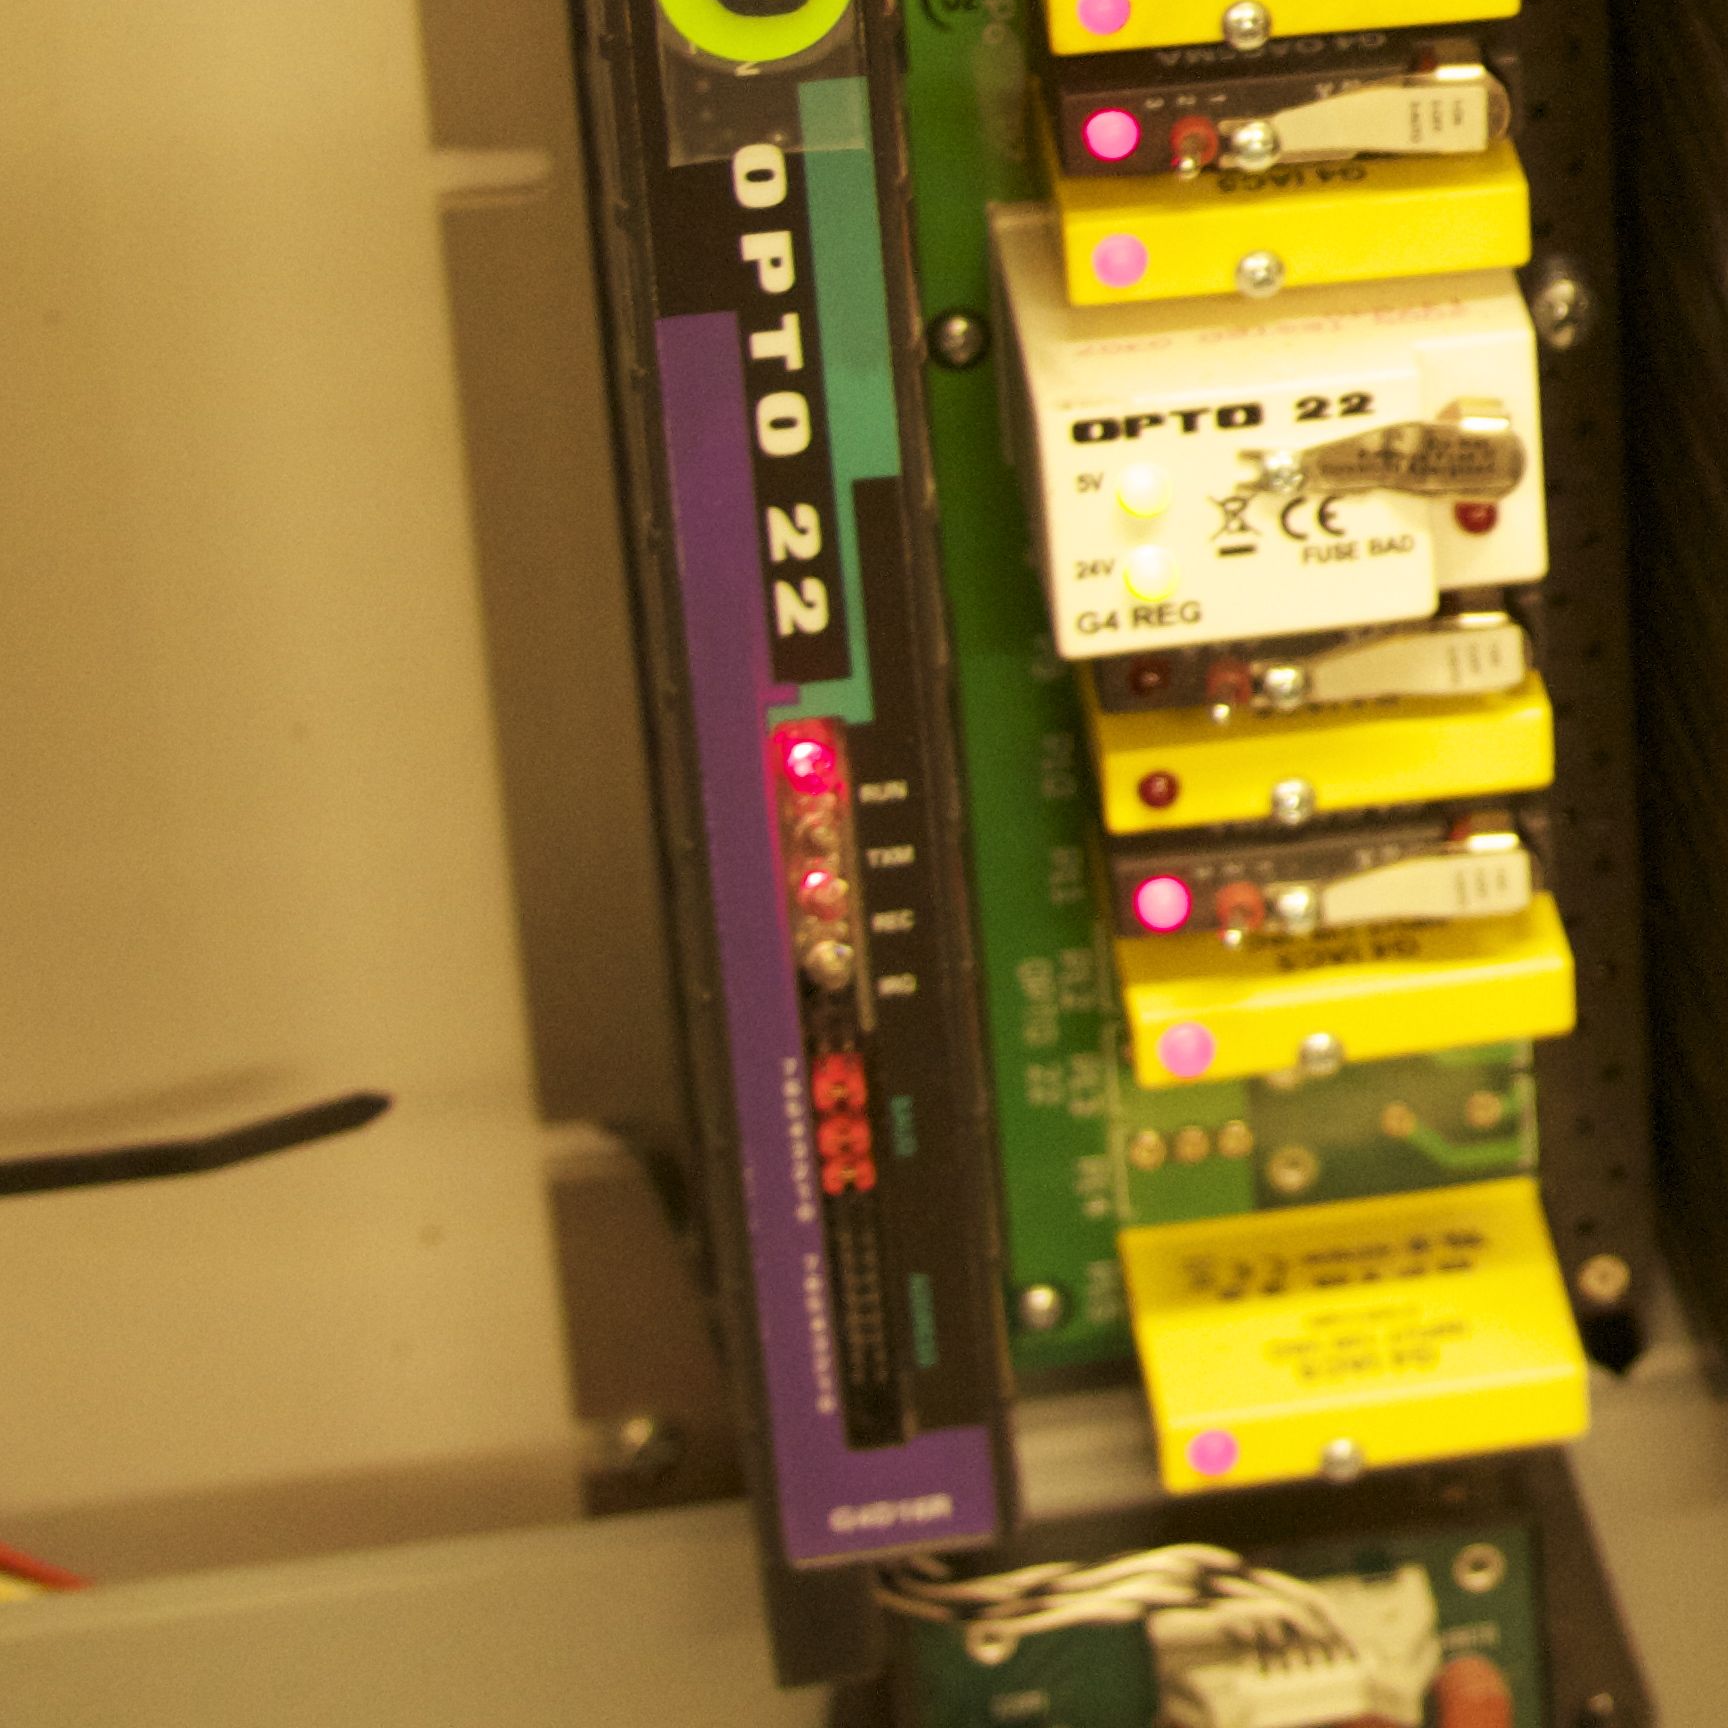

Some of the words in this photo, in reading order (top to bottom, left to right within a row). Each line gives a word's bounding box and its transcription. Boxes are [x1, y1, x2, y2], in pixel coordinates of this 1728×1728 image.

[731, 143, 812, 457] OPTO
[1071, 401, 1265, 443] OPTO
[1295, 391, 1375, 422] 22
[765, 502, 830, 637] 22
[1302, 540, 1359, 565] FUSE
[1370, 534, 1415, 557] BAD
[1075, 610, 1120, 635] G4
[1131, 600, 1202, 626] REG
